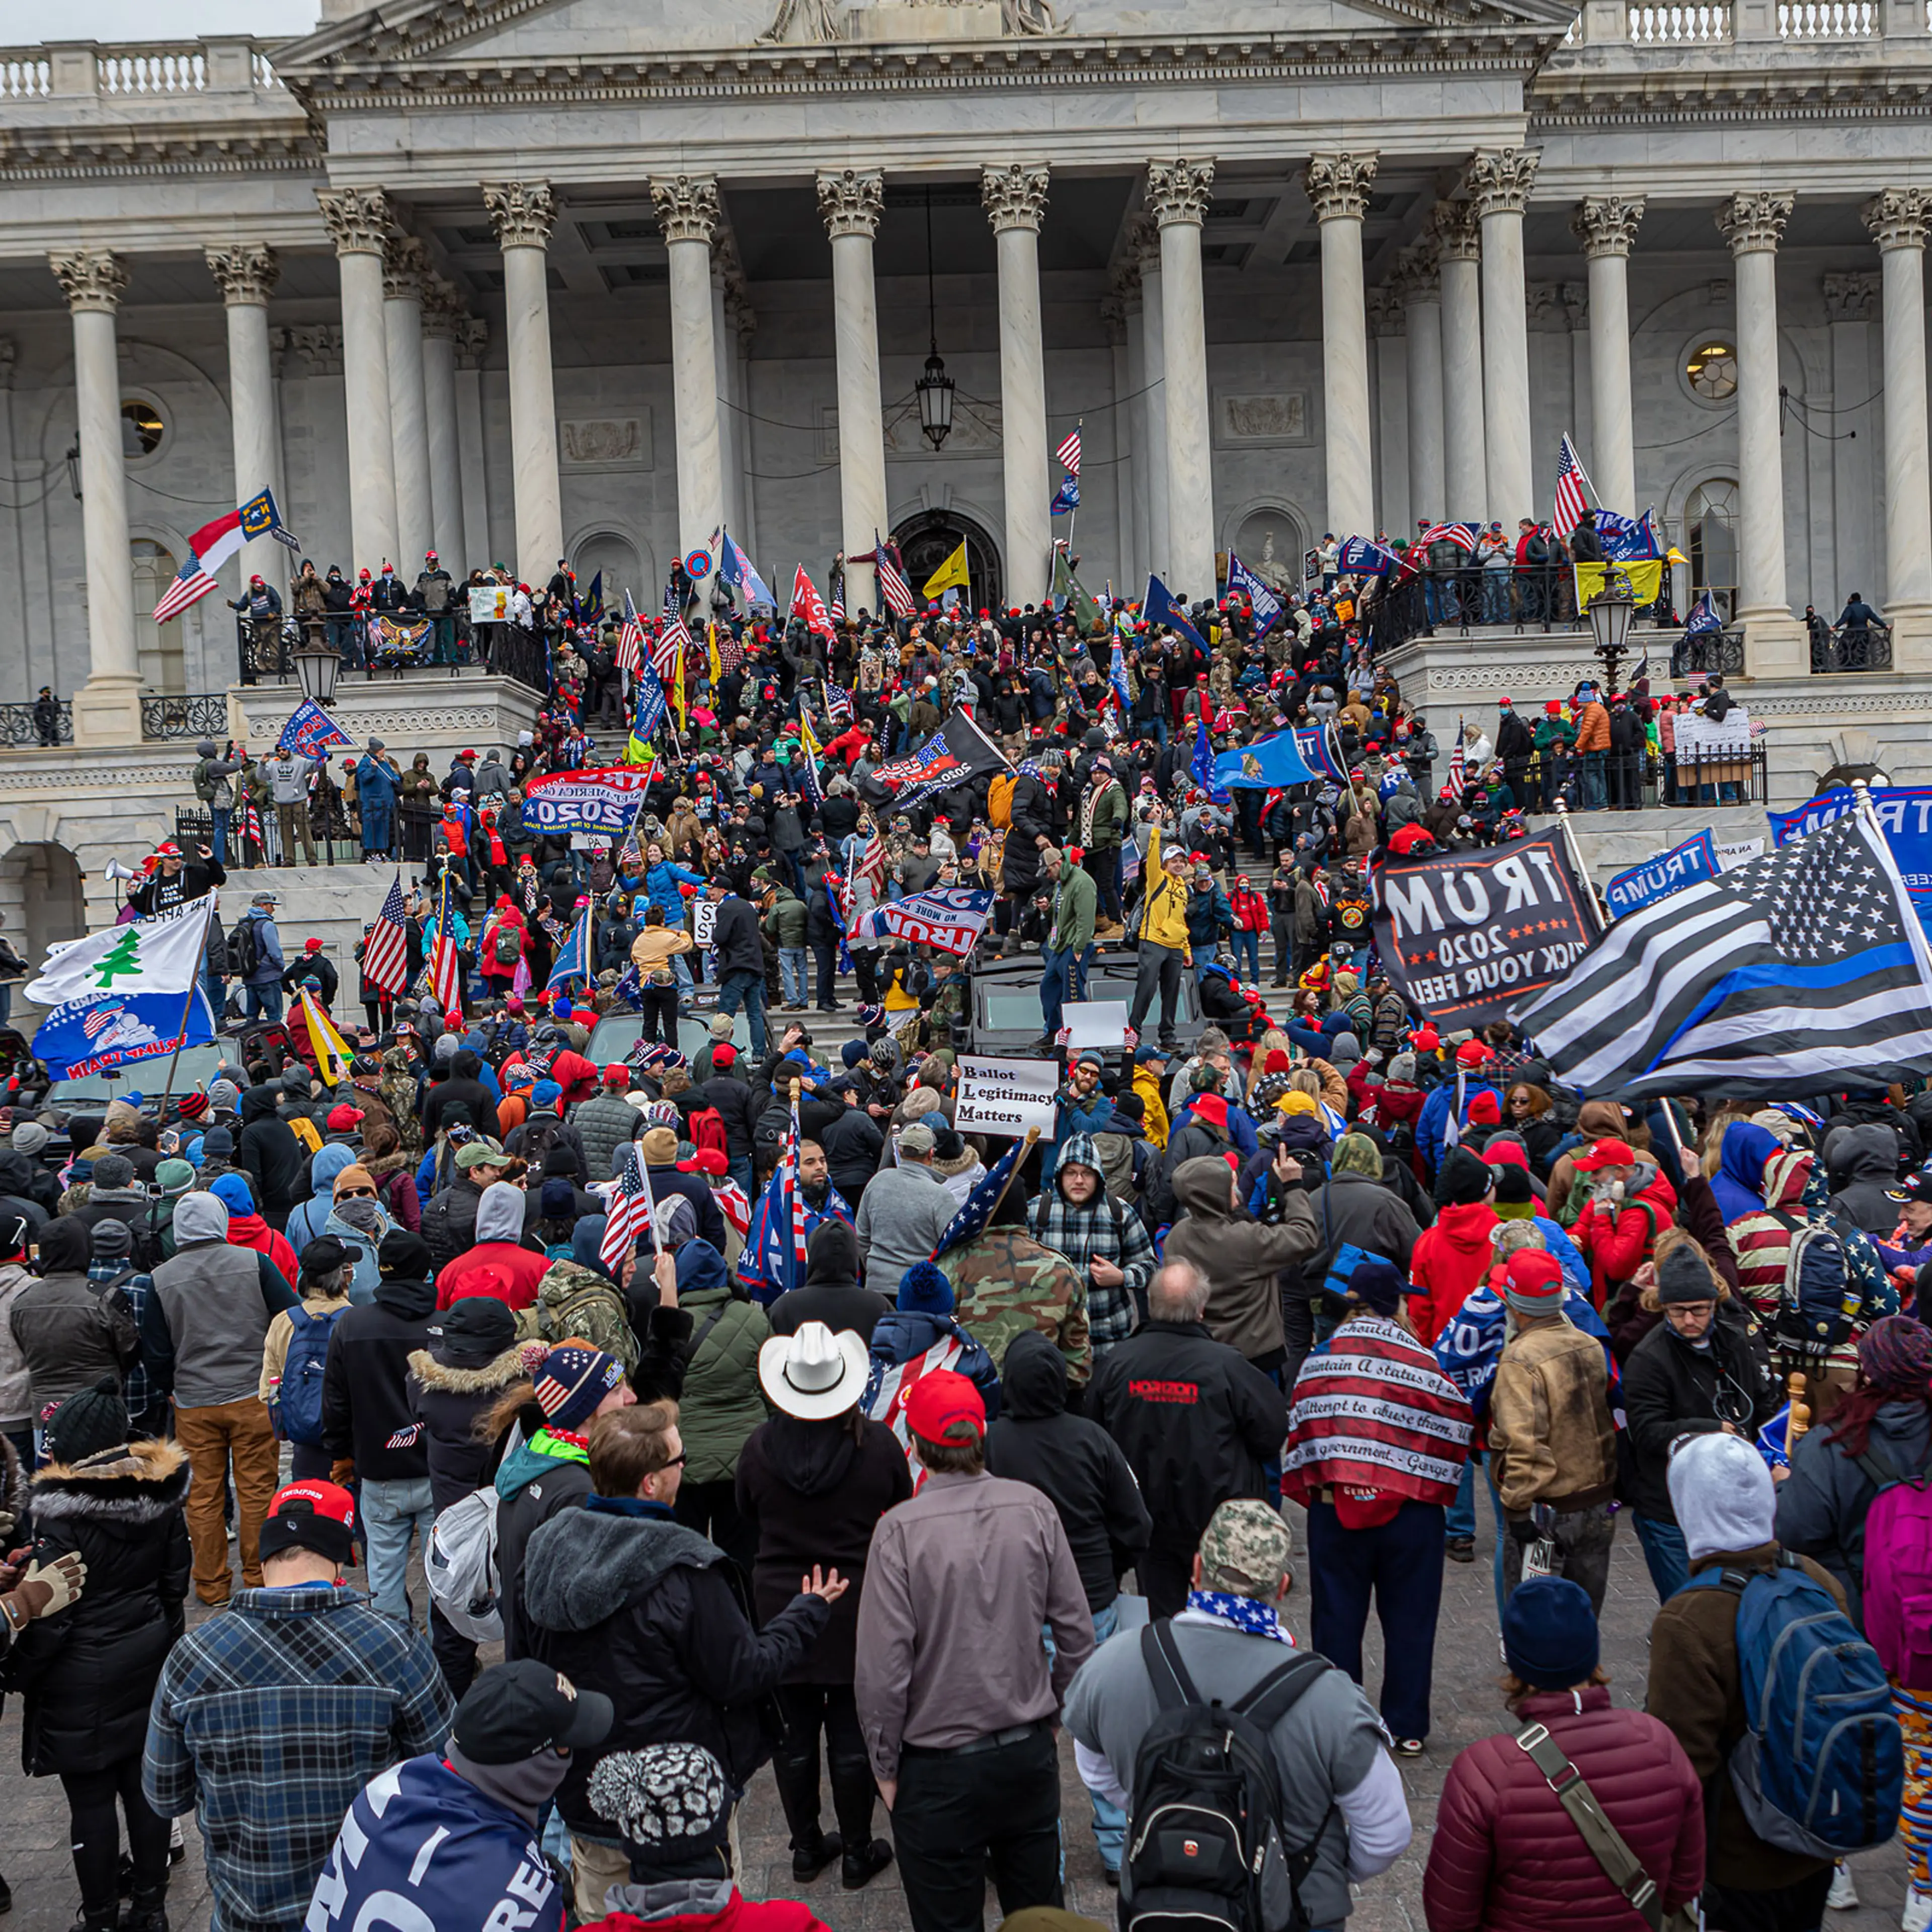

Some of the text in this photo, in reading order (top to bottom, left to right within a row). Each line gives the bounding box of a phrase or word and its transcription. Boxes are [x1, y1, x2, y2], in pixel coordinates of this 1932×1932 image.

[915, 904, 941, 921] MORE
[944, 914, 957, 922] NO
[963, 1066, 1016, 1080] Ballot
[962, 1084, 1055, 1106] Legitimacy
[957, 1105, 1022, 1122] Matters
[1357, 1359, 1373, 1373] A
[1377, 1365, 1423, 1384] status
[1427, 1374, 1444, 1393] of
[1352, 1401, 1367, 1414] to
[1372, 1403, 1415, 1424] abuse
[1417, 1415, 1454, 1437] them,
